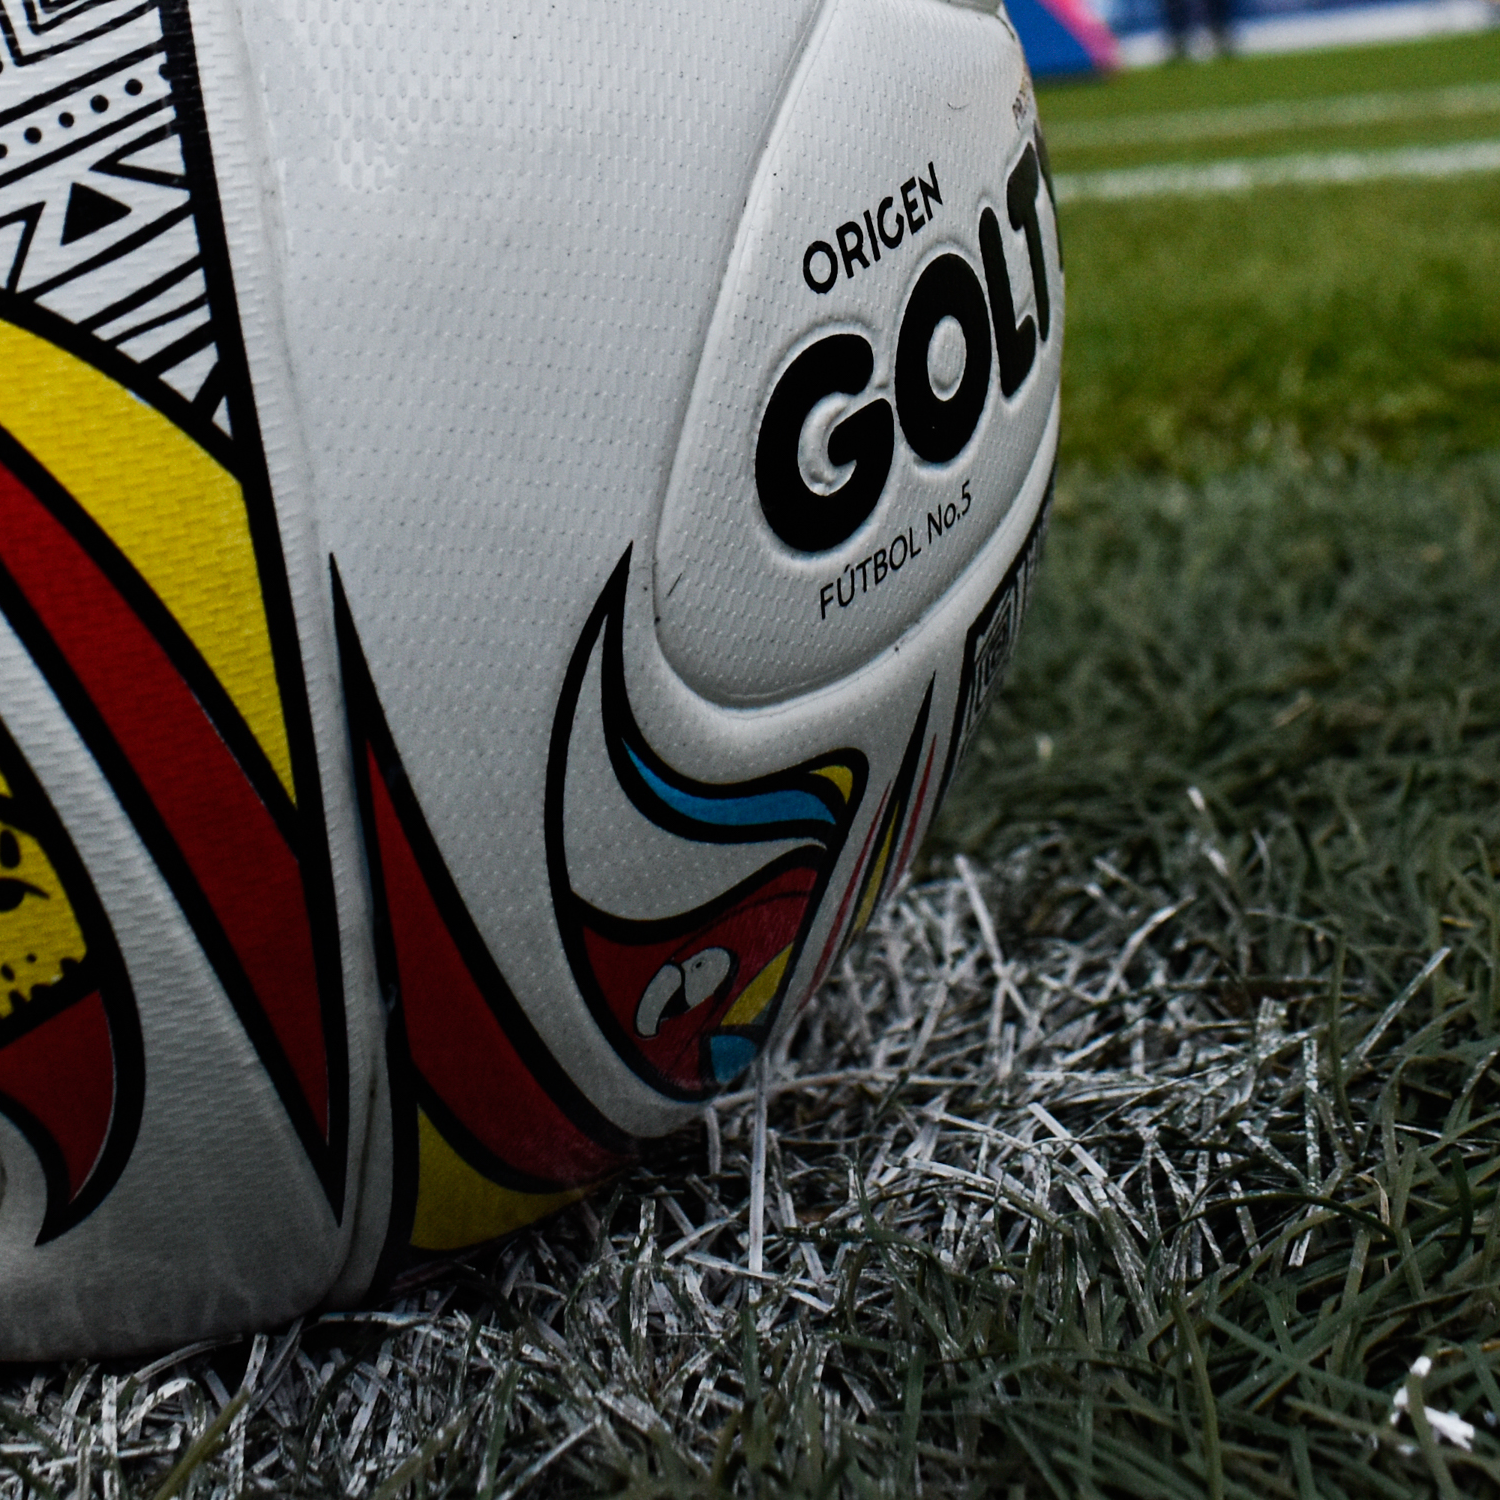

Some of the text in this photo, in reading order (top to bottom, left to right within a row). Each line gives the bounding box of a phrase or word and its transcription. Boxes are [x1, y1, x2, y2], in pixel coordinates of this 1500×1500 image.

[802, 161, 944, 295] ORIGEN
[754, 119, 1064, 553] GOLT
[818, 479, 974, 620] FÚTBOL No.5
